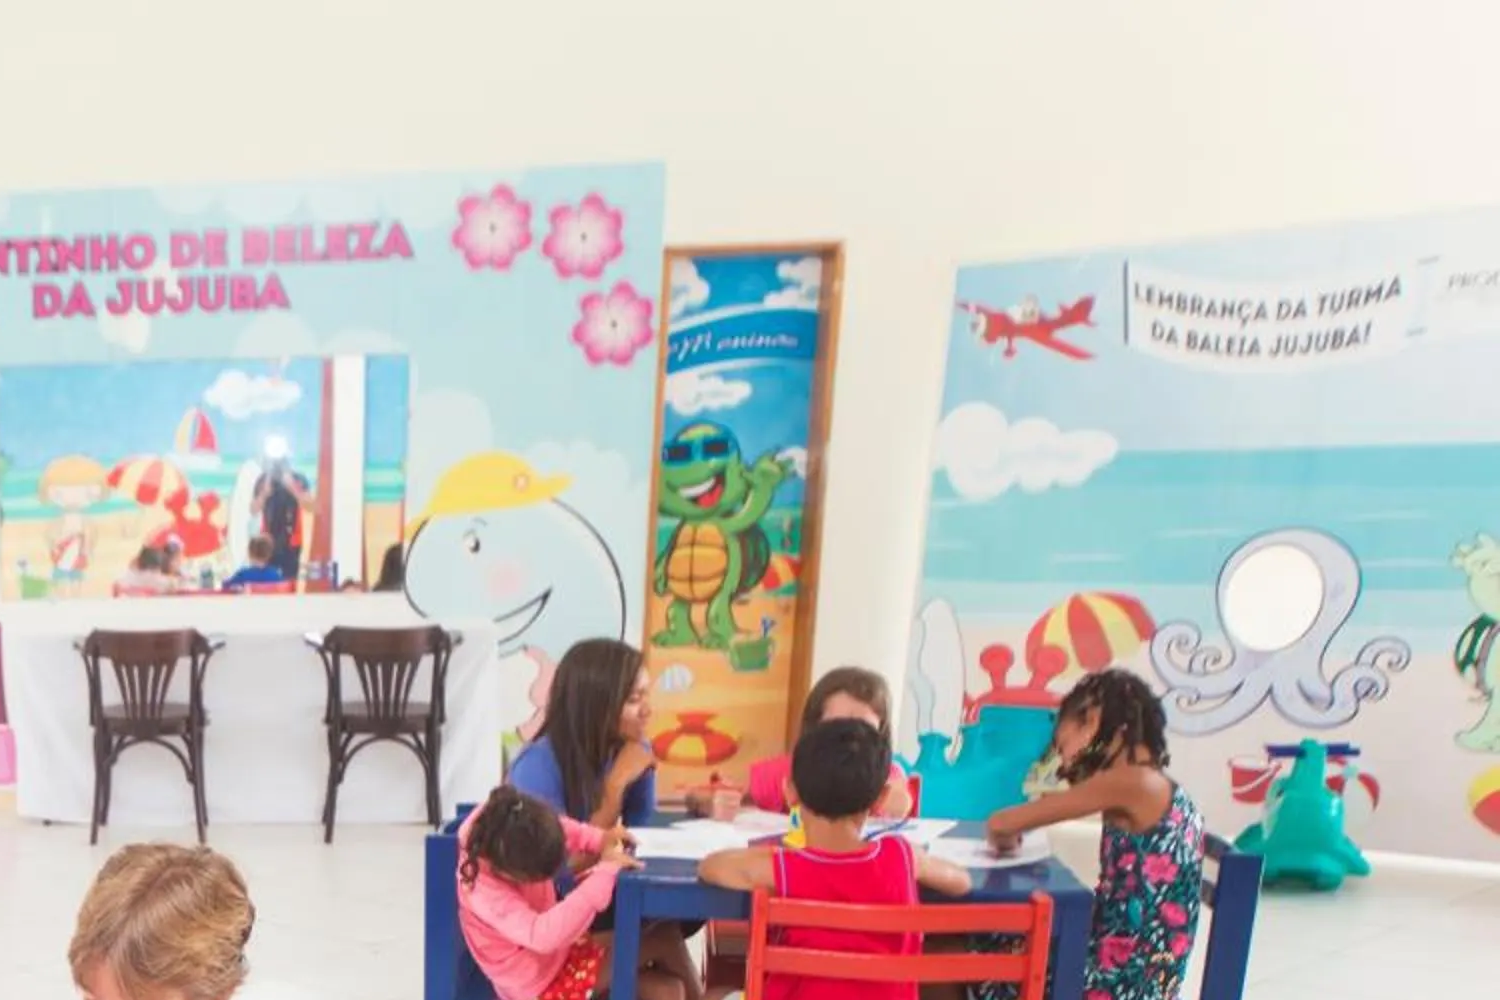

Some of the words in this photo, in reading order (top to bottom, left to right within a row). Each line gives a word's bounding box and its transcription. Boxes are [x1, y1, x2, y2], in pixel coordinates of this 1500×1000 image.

[168, 229, 228, 269] DE
[241, 219, 416, 266] BELEZA
[32, 280, 97, 319] DA
[105, 272, 292, 317] JUJUBA
[1134, 281, 1268, 328] LEMBRANÇA
[1276, 298, 1307, 321] DA
[1317, 273, 1400, 317] TURMA
[1151, 318, 1178, 346] DA
[1186, 329, 1260, 358] BALEIA
[1268, 319, 1372, 358] JUJUBA!
